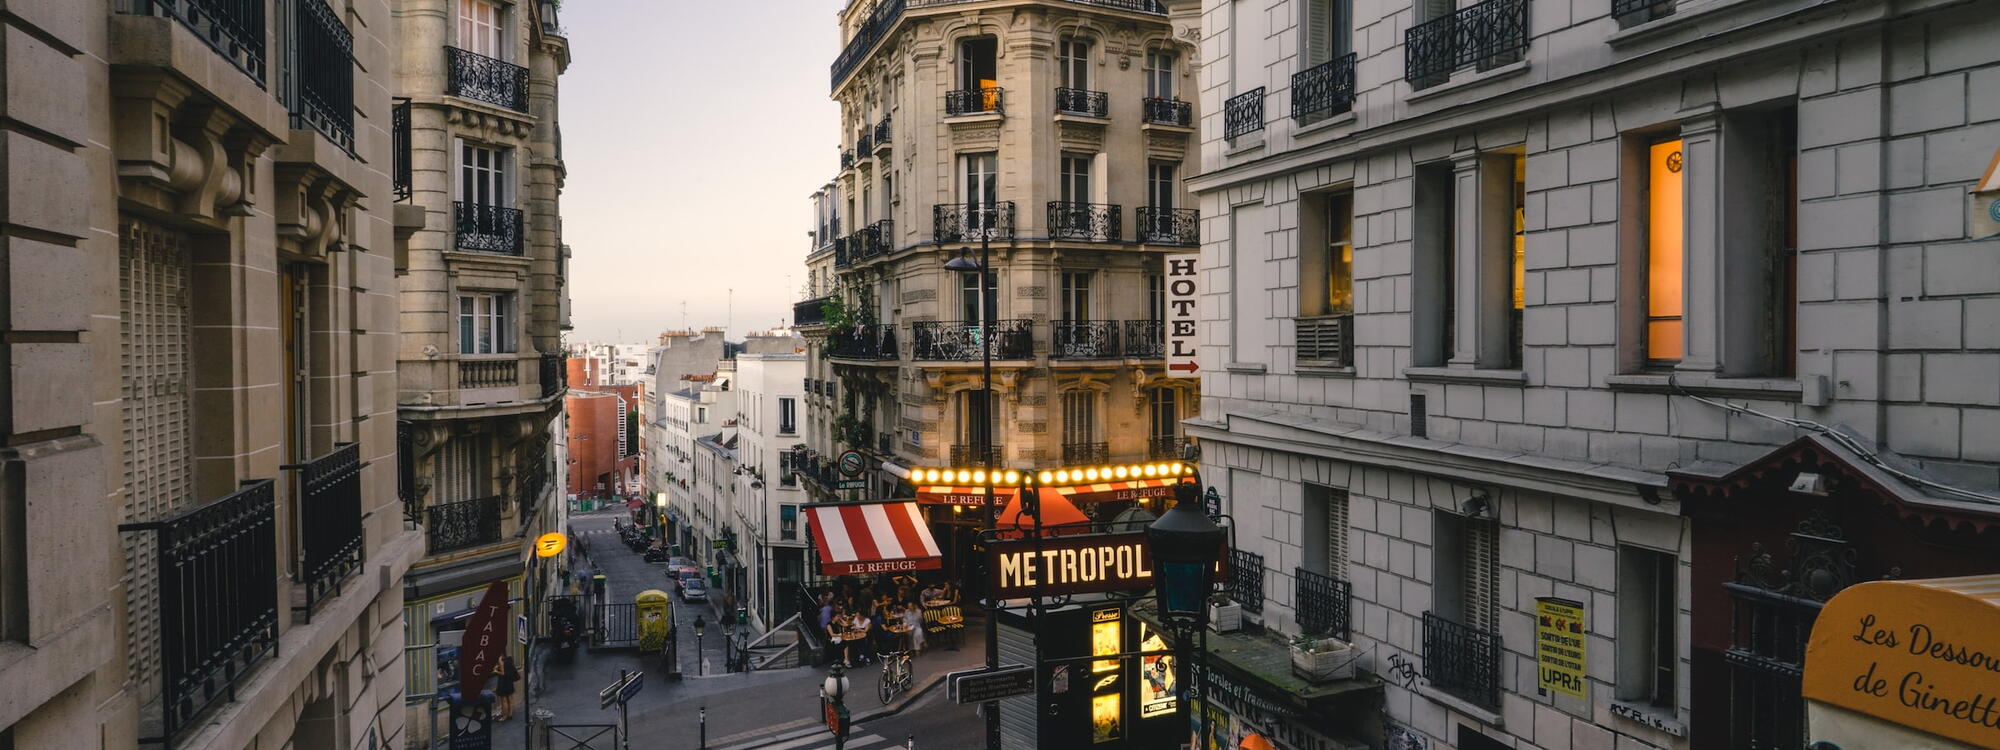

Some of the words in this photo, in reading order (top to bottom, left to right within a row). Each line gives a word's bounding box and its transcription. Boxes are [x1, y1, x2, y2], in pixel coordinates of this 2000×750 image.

[1169, 259, 1197, 356] HOTEL
[943, 495, 957, 504] LE
[960, 495, 1003, 504] REFUE
[1117, 490, 1129, 500] LE
[1131, 488, 1166, 499] REFUGE
[848, 563, 865, 573] LE
[868, 560, 916, 572] REFUGE
[1001, 544, 1219, 588] METROPOL
[472, 605, 498, 676] TABAC
[1853, 614, 1900, 648] Les
[1853, 662, 1889, 697] de
